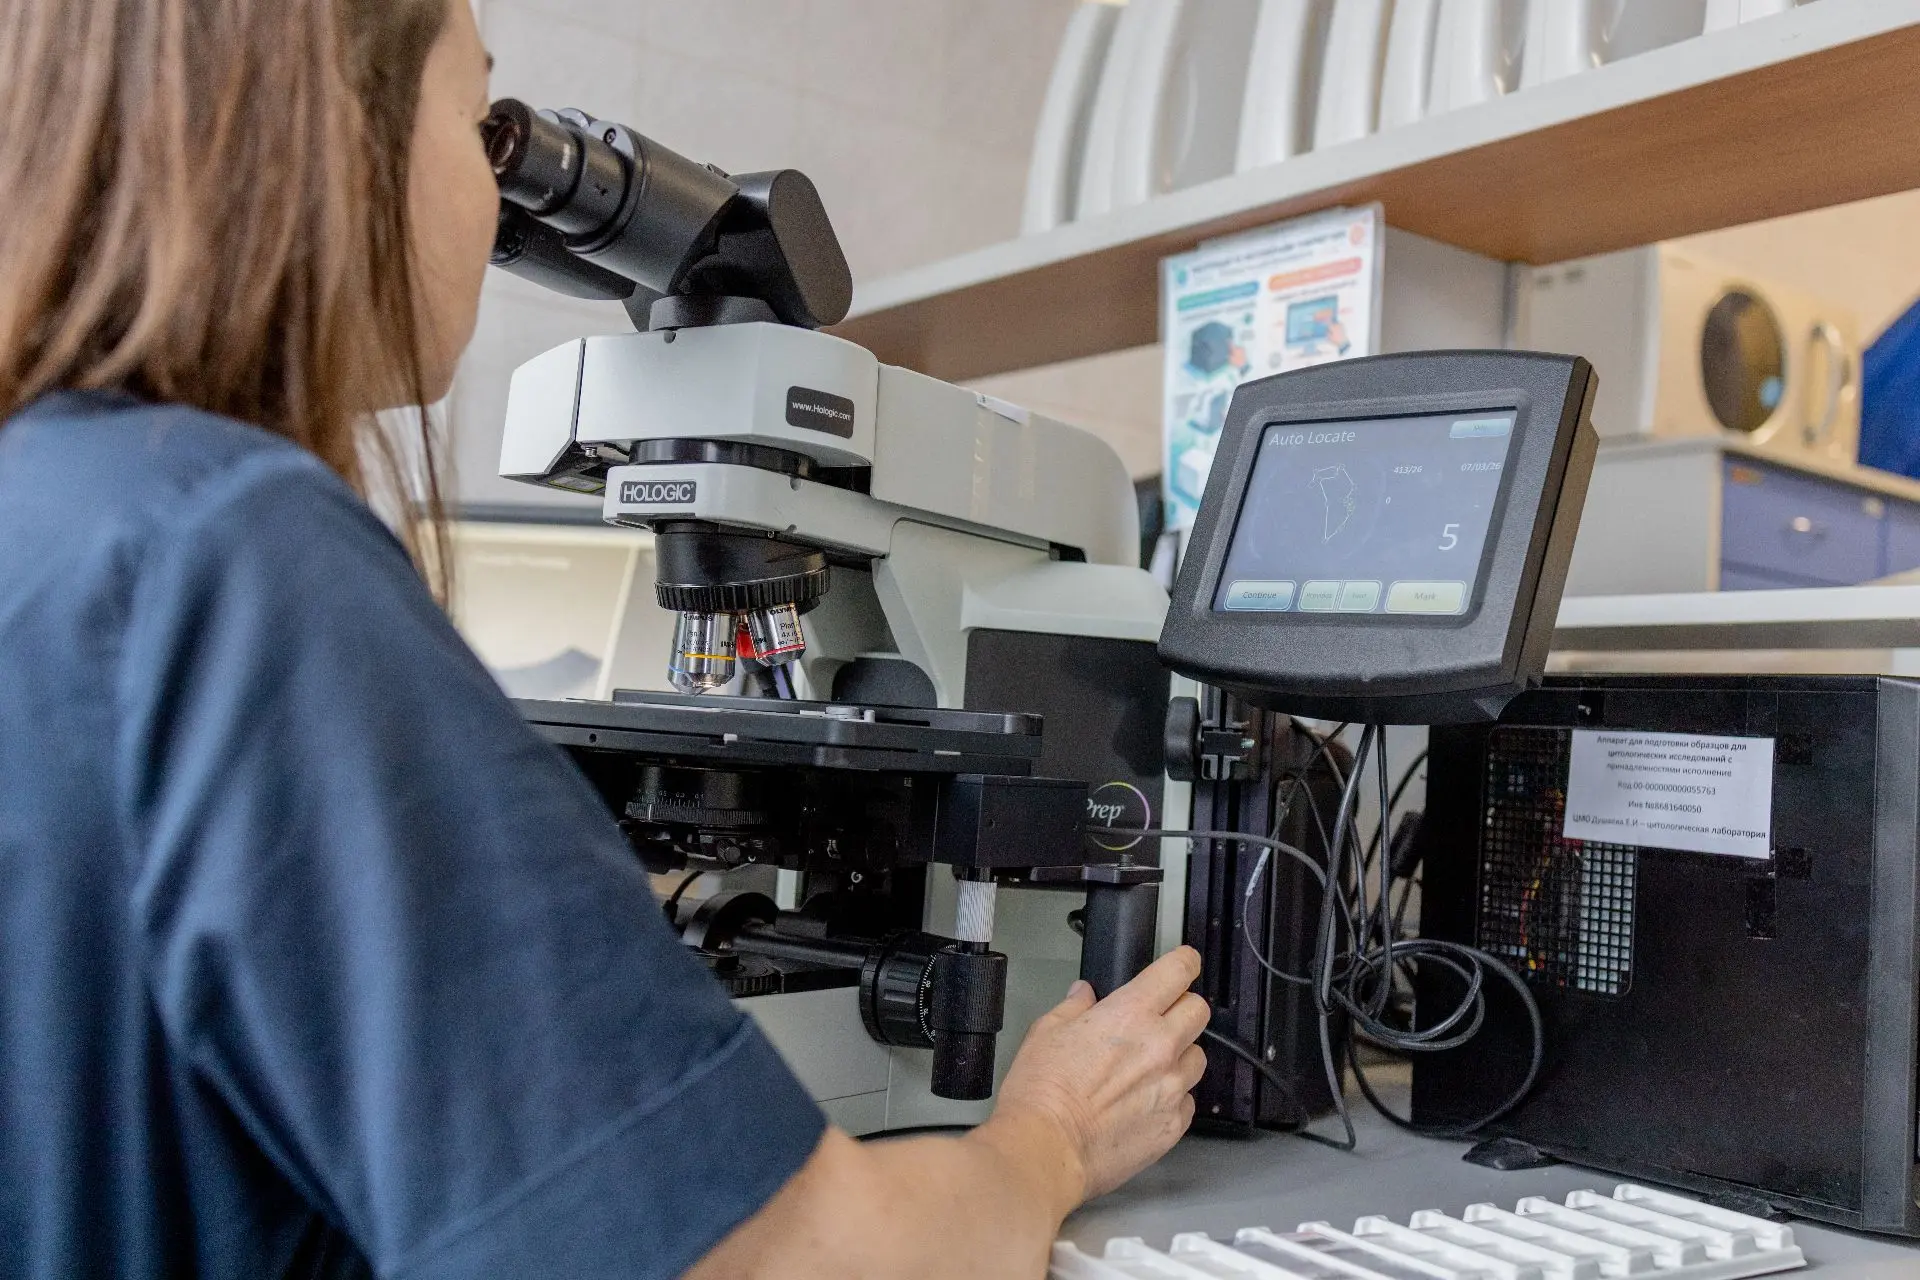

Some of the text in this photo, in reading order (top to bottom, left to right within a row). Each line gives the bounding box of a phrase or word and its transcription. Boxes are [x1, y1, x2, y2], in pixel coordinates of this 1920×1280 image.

[1268, 431, 1356, 447] Auto Locate
[1460, 461, 1502, 473] 07/03/26
[623, 483, 691, 502] HOLOGIC
[1437, 523, 1460, 551] 5
[1242, 591, 1278, 599] Continue
[1597, 735, 1747, 751] Аппарат для подготовки образцов для
[1607, 750, 1667, 760] цитологических
[1669, 753, 1726, 764] исследований
[1682, 767, 1732, 777] исполнение
[1646, 821, 1710, 833] цитологическая
[1711, 827, 1766, 839] лаборатория
